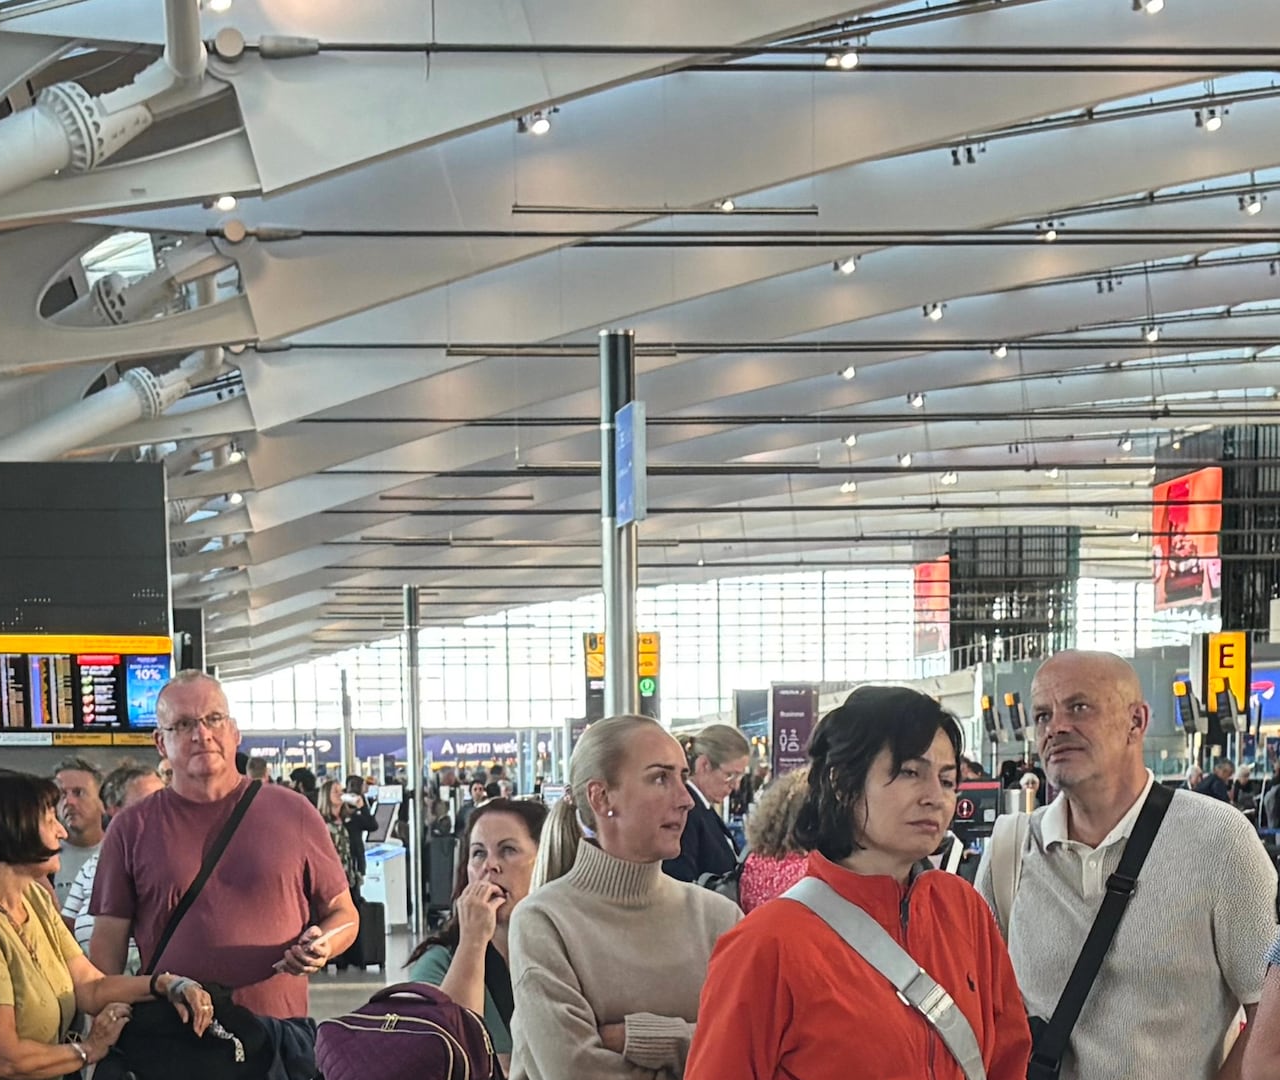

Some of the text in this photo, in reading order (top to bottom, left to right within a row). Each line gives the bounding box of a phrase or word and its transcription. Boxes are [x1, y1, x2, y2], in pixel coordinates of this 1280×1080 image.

[1219, 643, 1234, 668] E
[135, 669, 161, 680] 10%
[440, 739, 454, 754] A
[455, 743, 491, 754] warm
